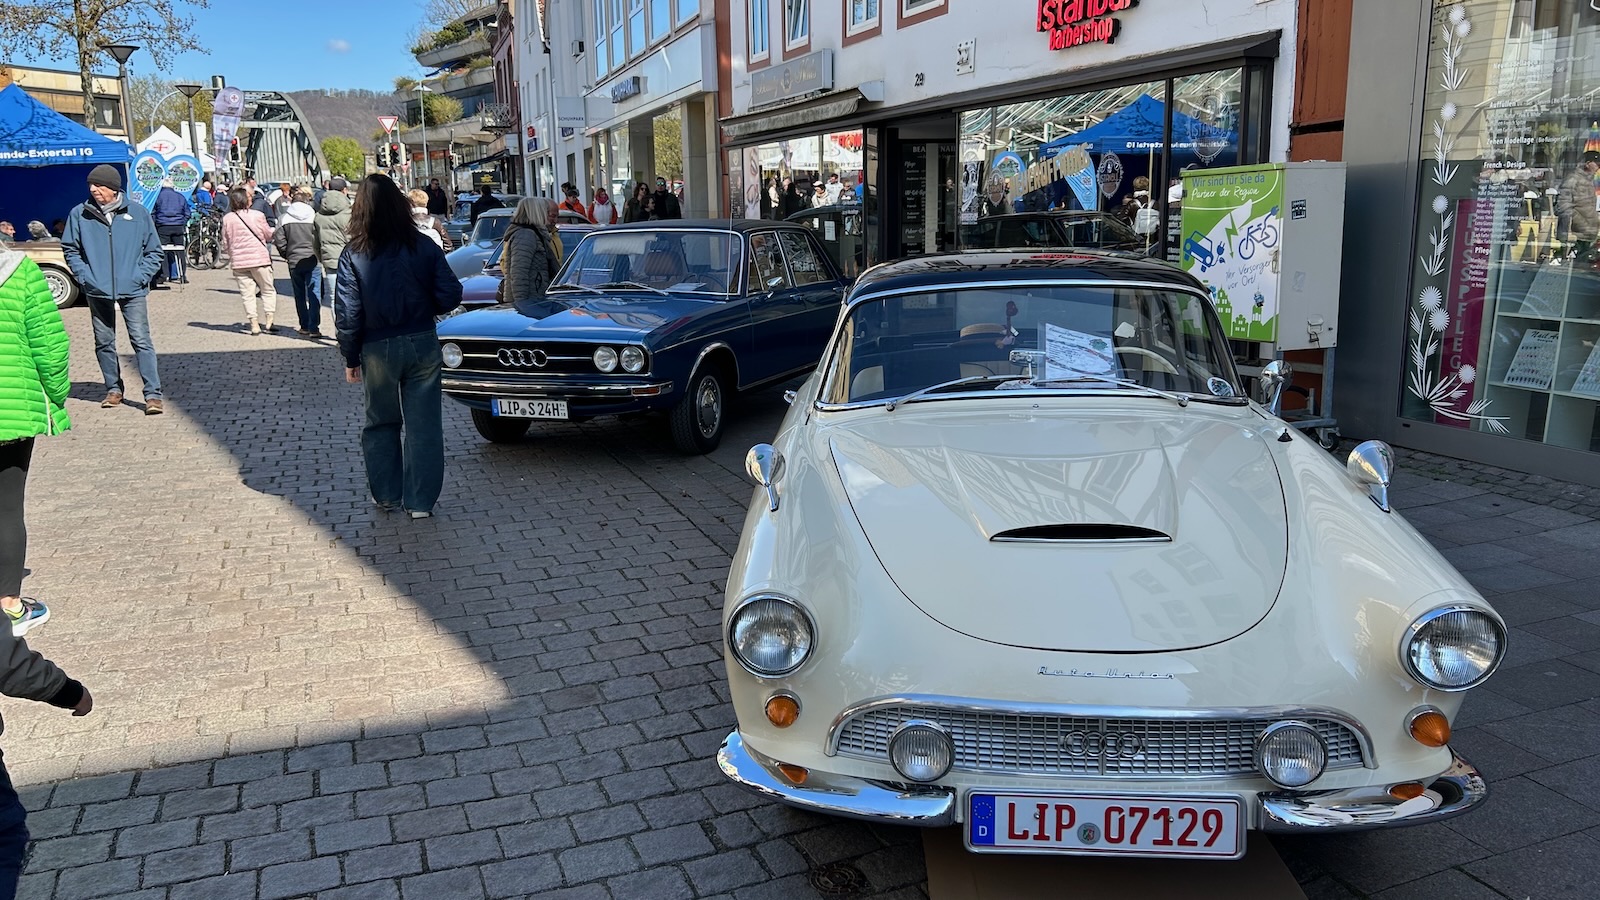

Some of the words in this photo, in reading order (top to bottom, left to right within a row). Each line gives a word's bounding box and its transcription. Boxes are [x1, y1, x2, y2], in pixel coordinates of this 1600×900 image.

[1049, 18, 1113, 50] Barbershop
[914, 72, 924, 87] 29
[1504, 136, 1534, 145] Modellage
[80, 148, 93, 156] IG
[1506, 161, 1526, 169] Design
[1192, 178, 1206, 188] Wir
[1208, 176, 1224, 186] sind
[1226, 175, 1238, 185] für
[1240, 174, 1252, 184] Sie
[1254, 174, 1265, 183] da
[1191, 188, 1217, 200] Partner
[1219, 188, 1230, 197] der
[1234, 186, 1260, 200] Region
[1238, 260, 1272, 276] Versorger
[1228, 282, 1238, 290] vor
[500, 401, 520, 415] LIP
[528, 402, 535, 416] S
[537, 402, 560, 417] 24H
[1038, 666, 1094, 678] Auto
[1106, 668, 1175, 680] Union
[978, 825, 988, 837] D
[1008, 802, 1076, 842] LIP
[1104, 806, 1223, 848] 07129
